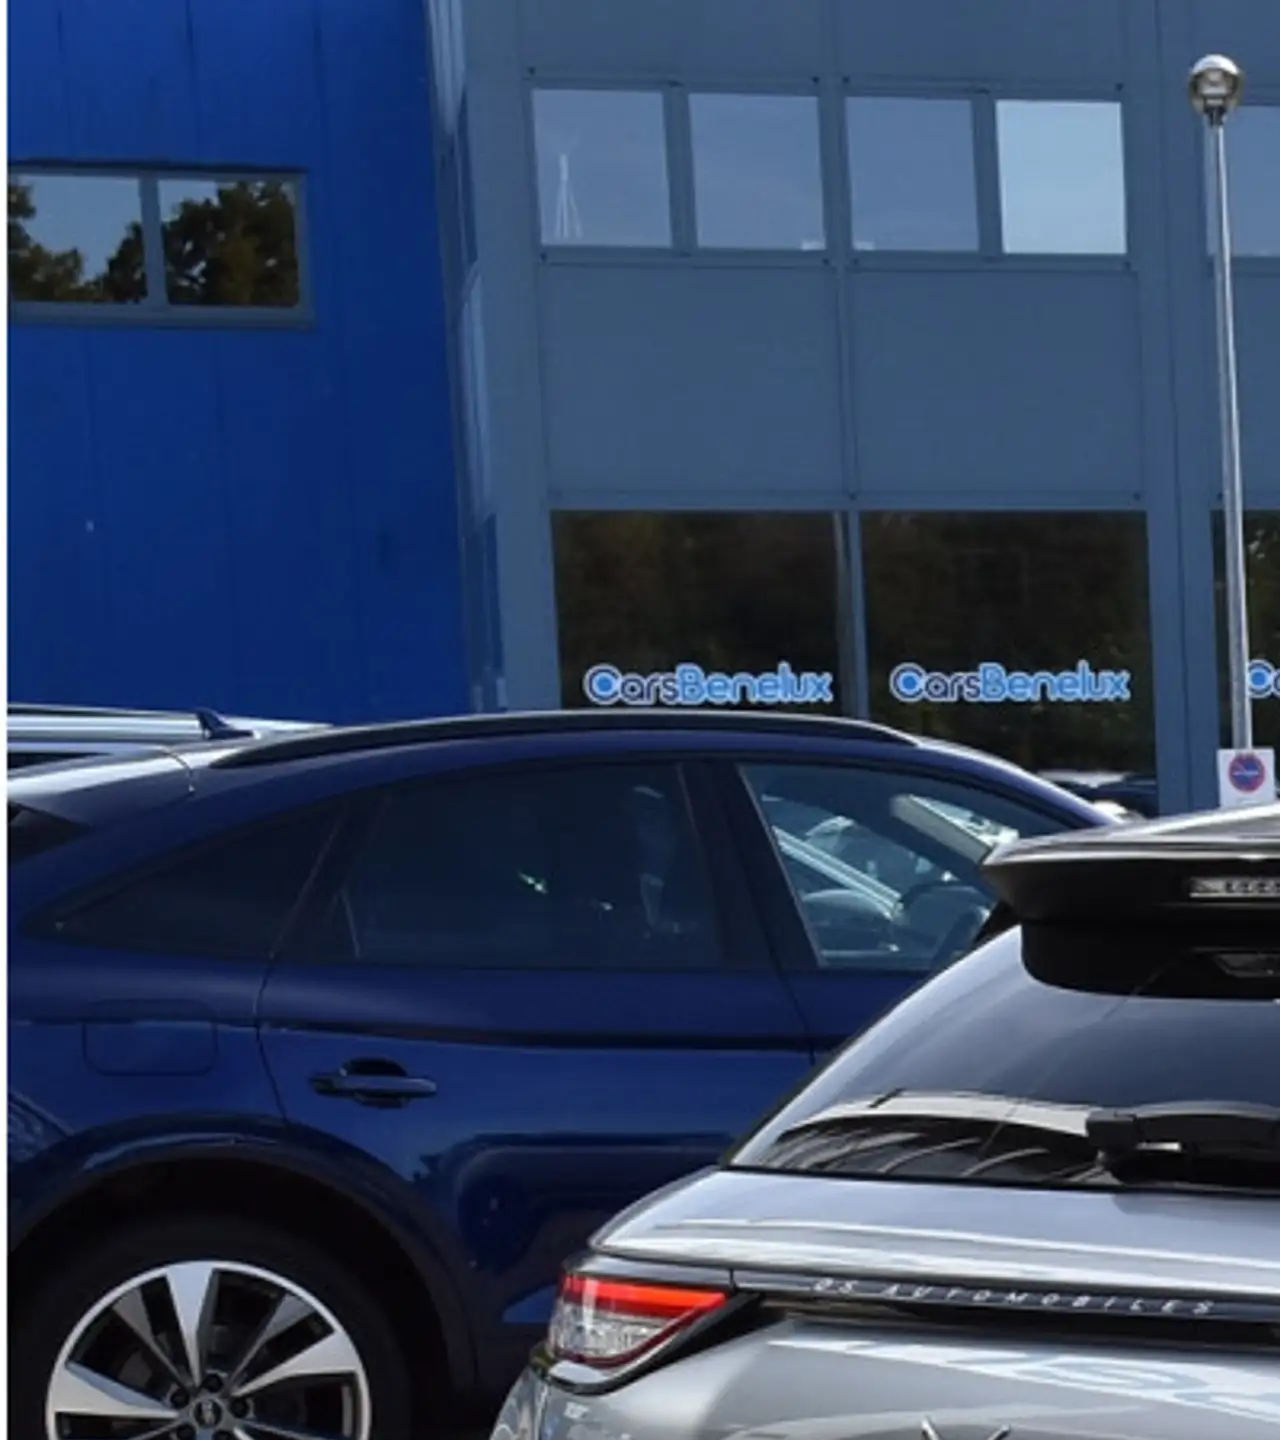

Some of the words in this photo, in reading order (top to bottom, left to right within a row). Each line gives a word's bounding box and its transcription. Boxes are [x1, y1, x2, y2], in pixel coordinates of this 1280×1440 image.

[584, 660, 833, 706] CarsBenelux
[889, 659, 1131, 702] CarsBenelux
[882, 1283, 1214, 1316] AUTOMOBILES
